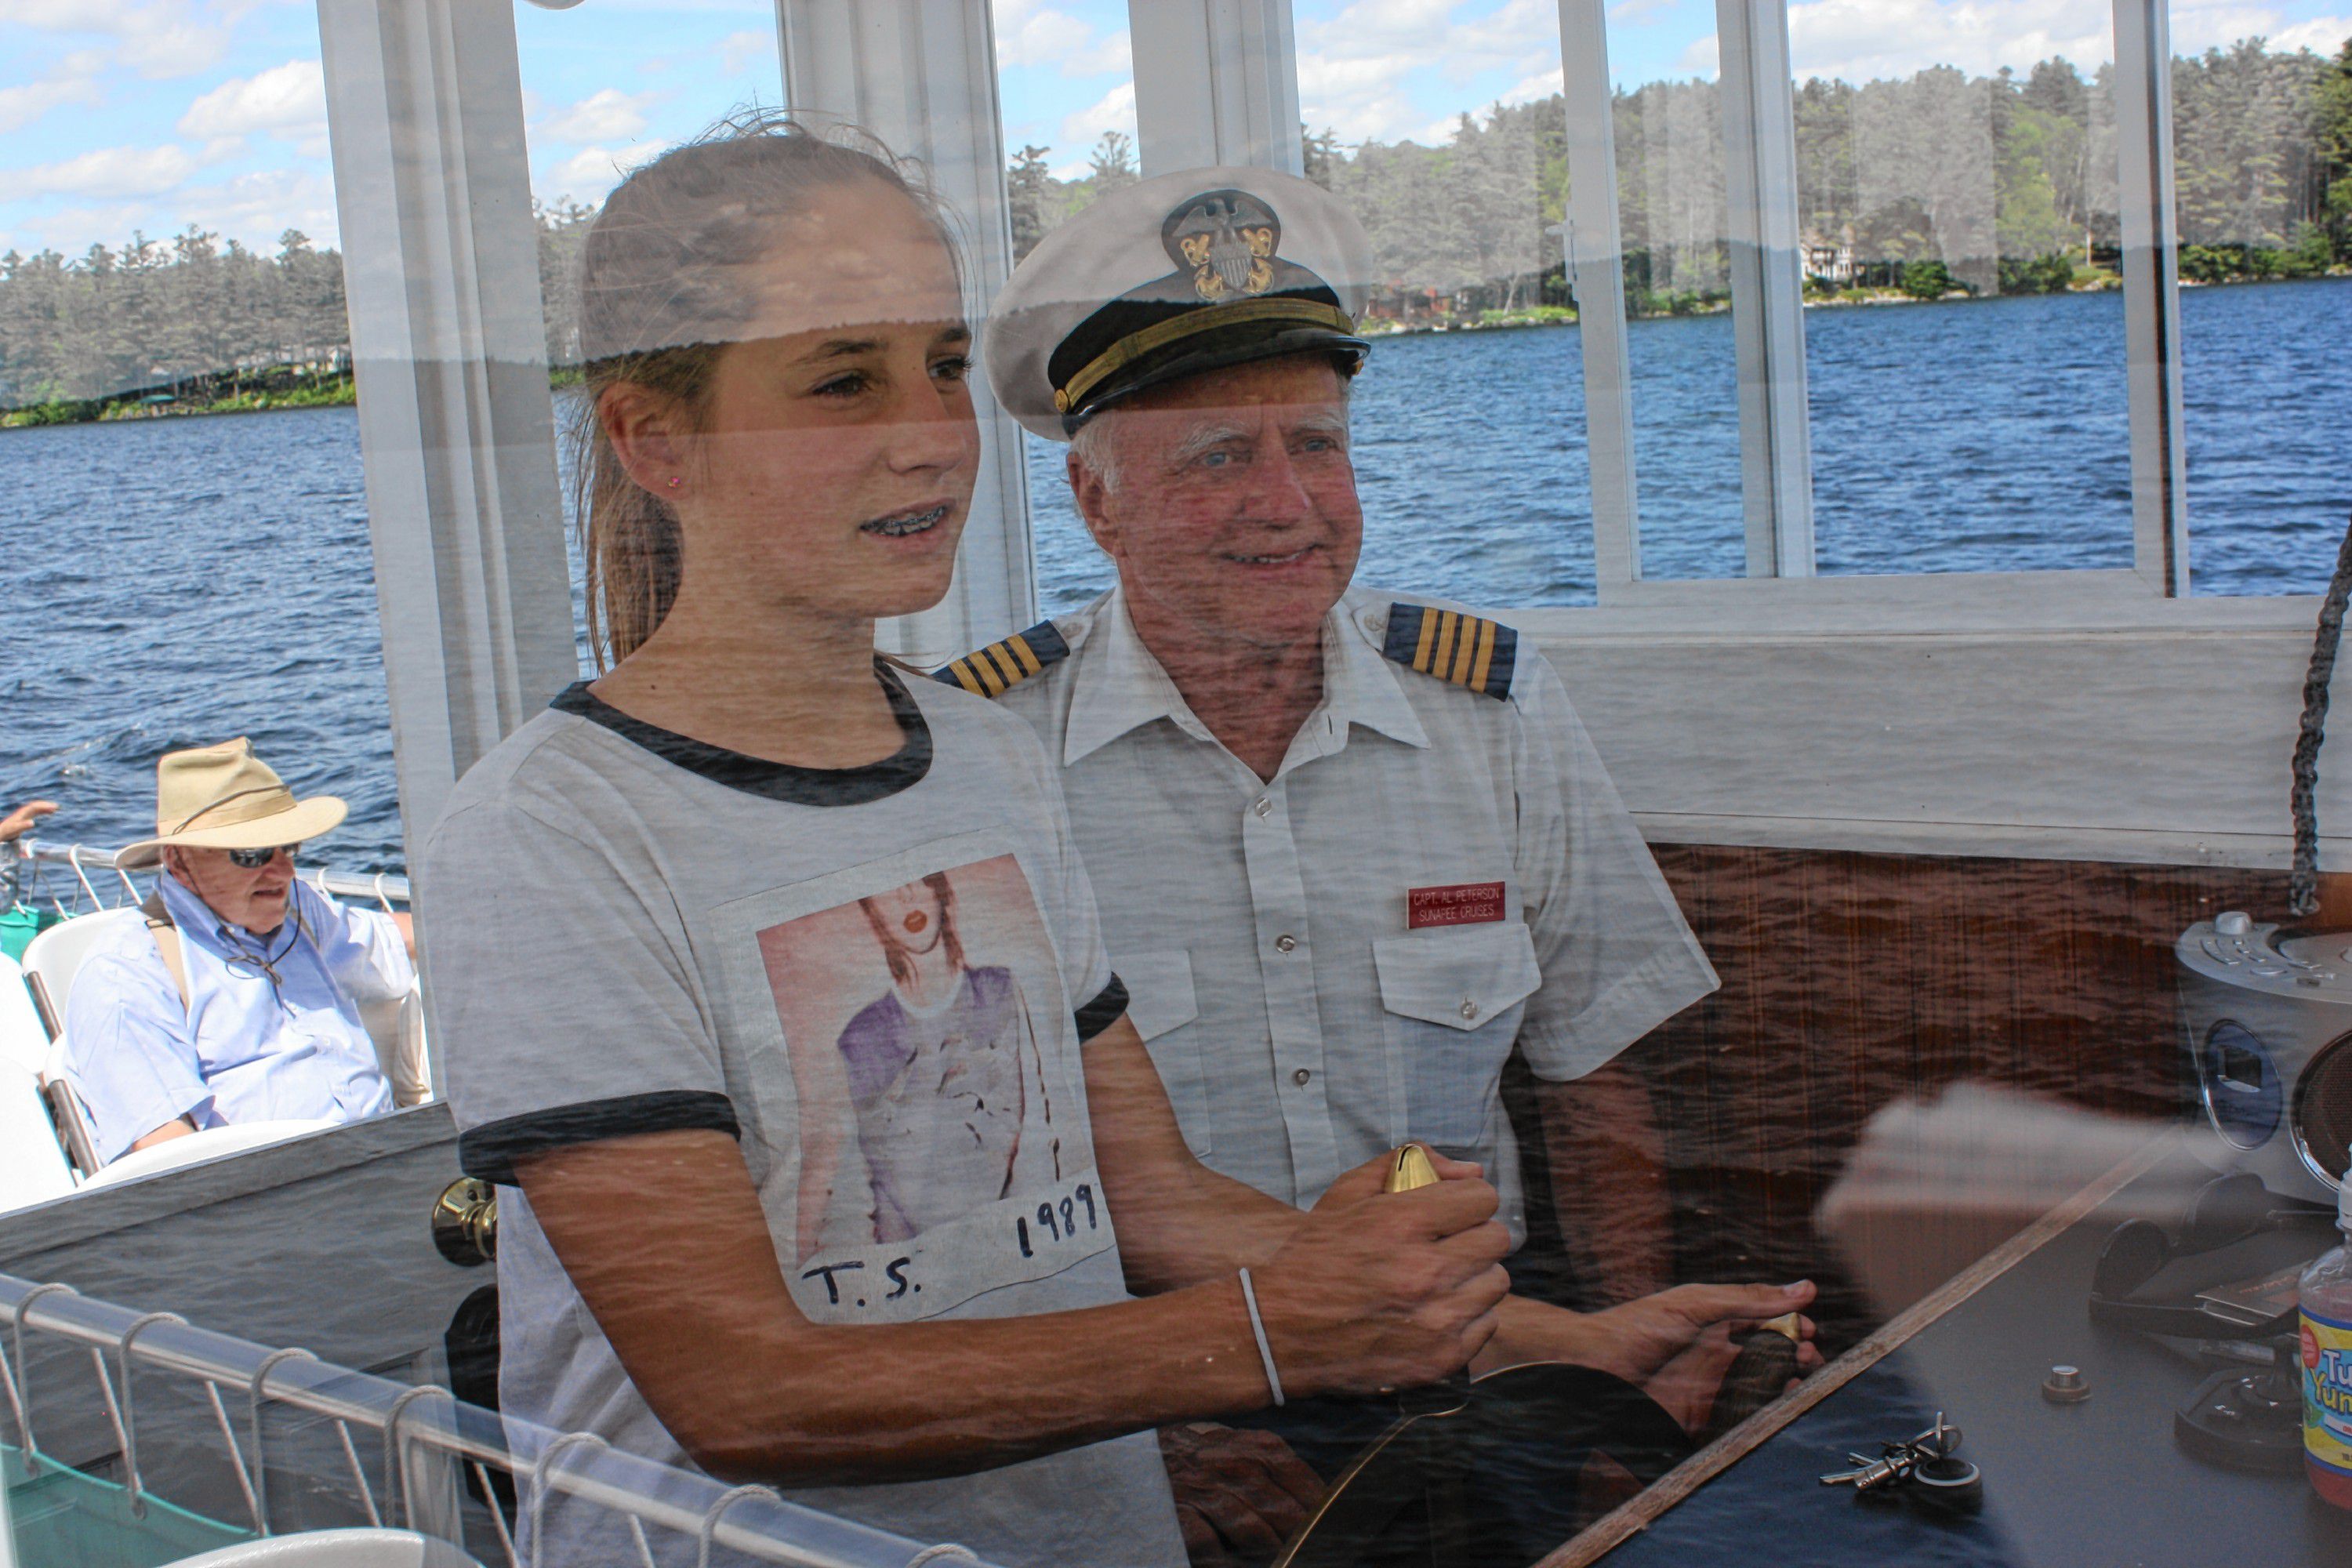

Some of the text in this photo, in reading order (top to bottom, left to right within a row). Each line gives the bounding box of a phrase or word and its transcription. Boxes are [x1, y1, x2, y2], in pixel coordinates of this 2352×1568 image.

[1414, 891, 1438, 906] CAPT.
[1442, 891, 1453, 904] AL
[1419, 904, 1494, 922] SUNAPEE CRUISES
[1017, 1184, 1097, 1258] 1989
